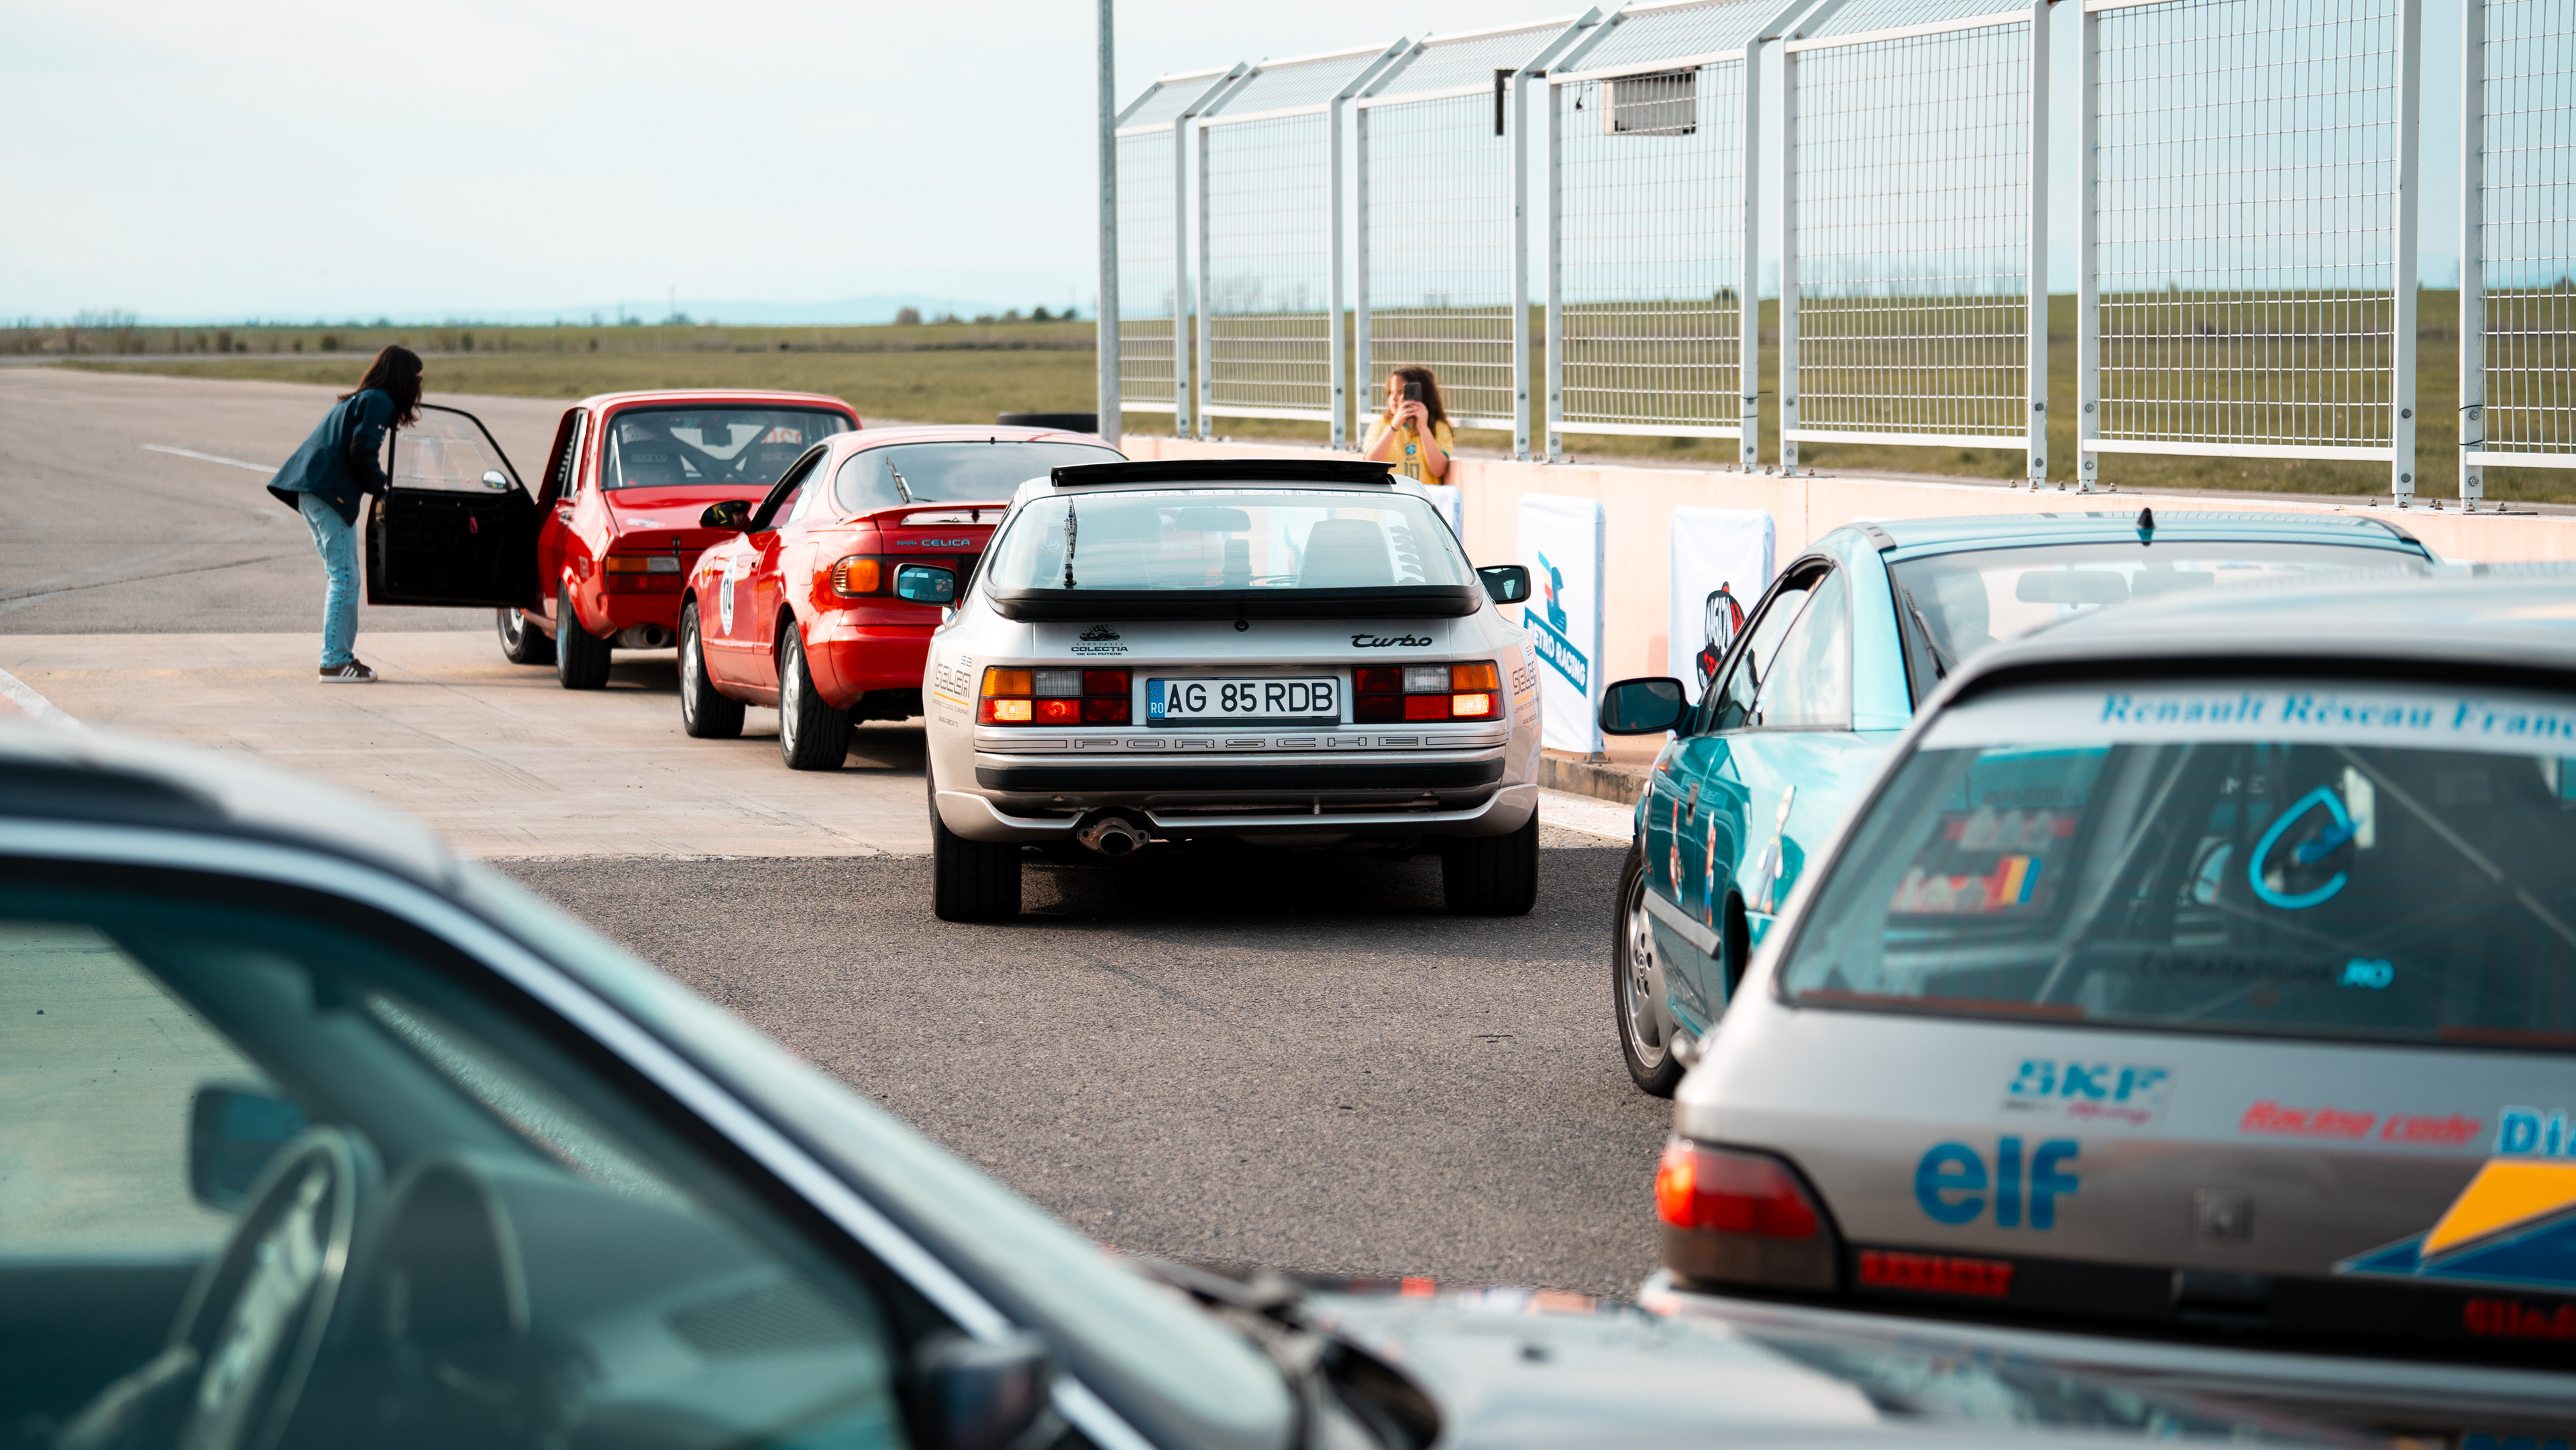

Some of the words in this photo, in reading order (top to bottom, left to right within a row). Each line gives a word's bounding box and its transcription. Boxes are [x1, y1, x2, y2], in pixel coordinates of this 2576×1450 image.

[1556, 641, 1587, 686] RACING
[1151, 703, 1164, 714] RO
[1167, 683, 1207, 713] AG
[1221, 683, 1257, 713] 85
[1265, 682, 1333, 713] RDB
[2100, 692, 2266, 725] Renault
[1075, 737, 1419, 749] PORSCHE
[2008, 1059, 2172, 1102] SKF
[1915, 1136, 2079, 1231] elf
